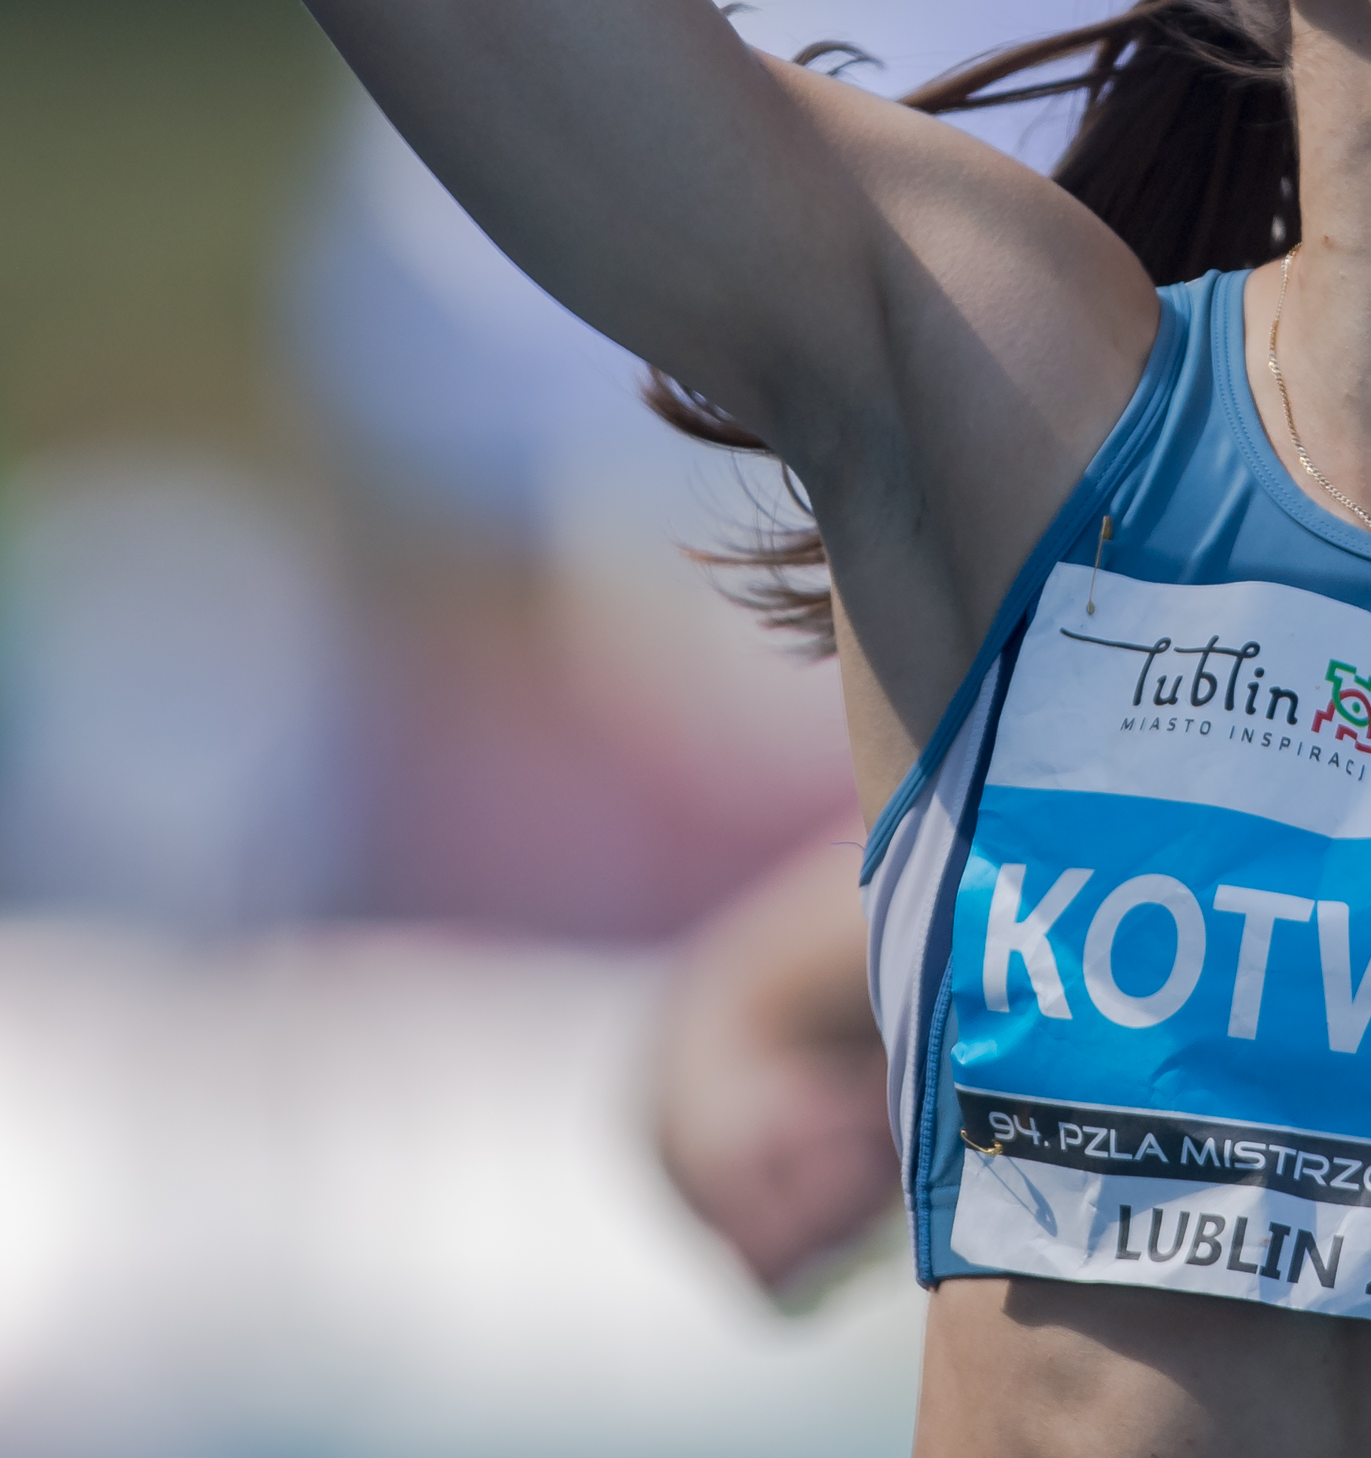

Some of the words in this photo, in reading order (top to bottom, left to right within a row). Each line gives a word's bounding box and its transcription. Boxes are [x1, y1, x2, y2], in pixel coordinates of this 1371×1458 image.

[1119, 716, 1212, 736] MIASTO
[988, 1110, 1050, 1148] 94.
[1058, 1121, 1169, 1164] PZLA
[1115, 1204, 1345, 1290] LUBLIN
